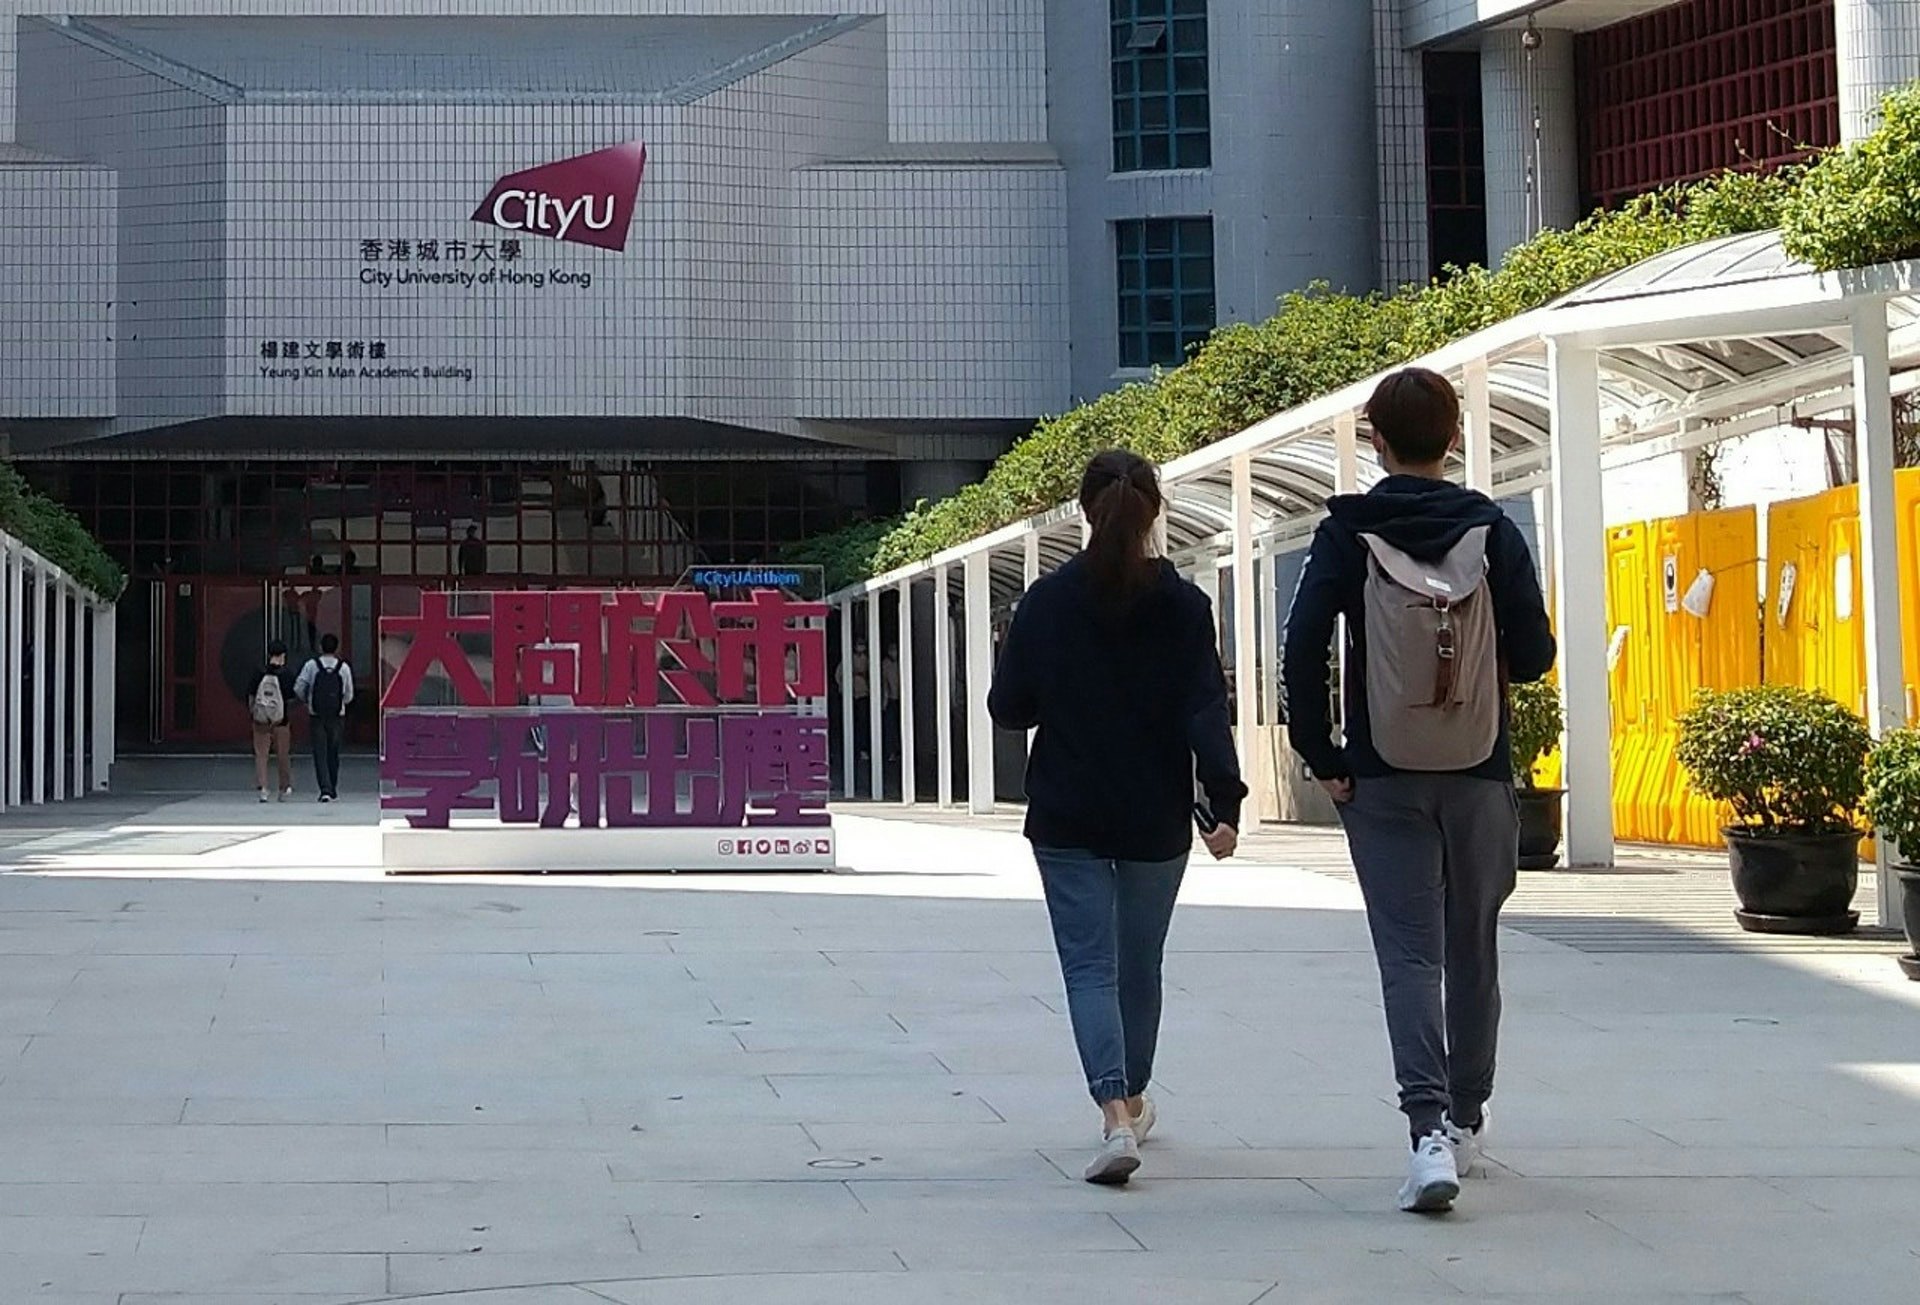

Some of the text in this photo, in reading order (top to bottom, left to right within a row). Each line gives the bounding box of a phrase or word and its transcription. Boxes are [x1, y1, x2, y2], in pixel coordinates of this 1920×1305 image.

[493, 190, 614, 239] CityU
[359, 238, 523, 262] 香港城市大學
[359, 267, 591, 289] City University of Hong Kong
[260, 366, 472, 381] Yeung Kin Man Academic Building
[694, 570, 801, 588] #CityUAnthem
[379, 590, 828, 707] 大問於市
